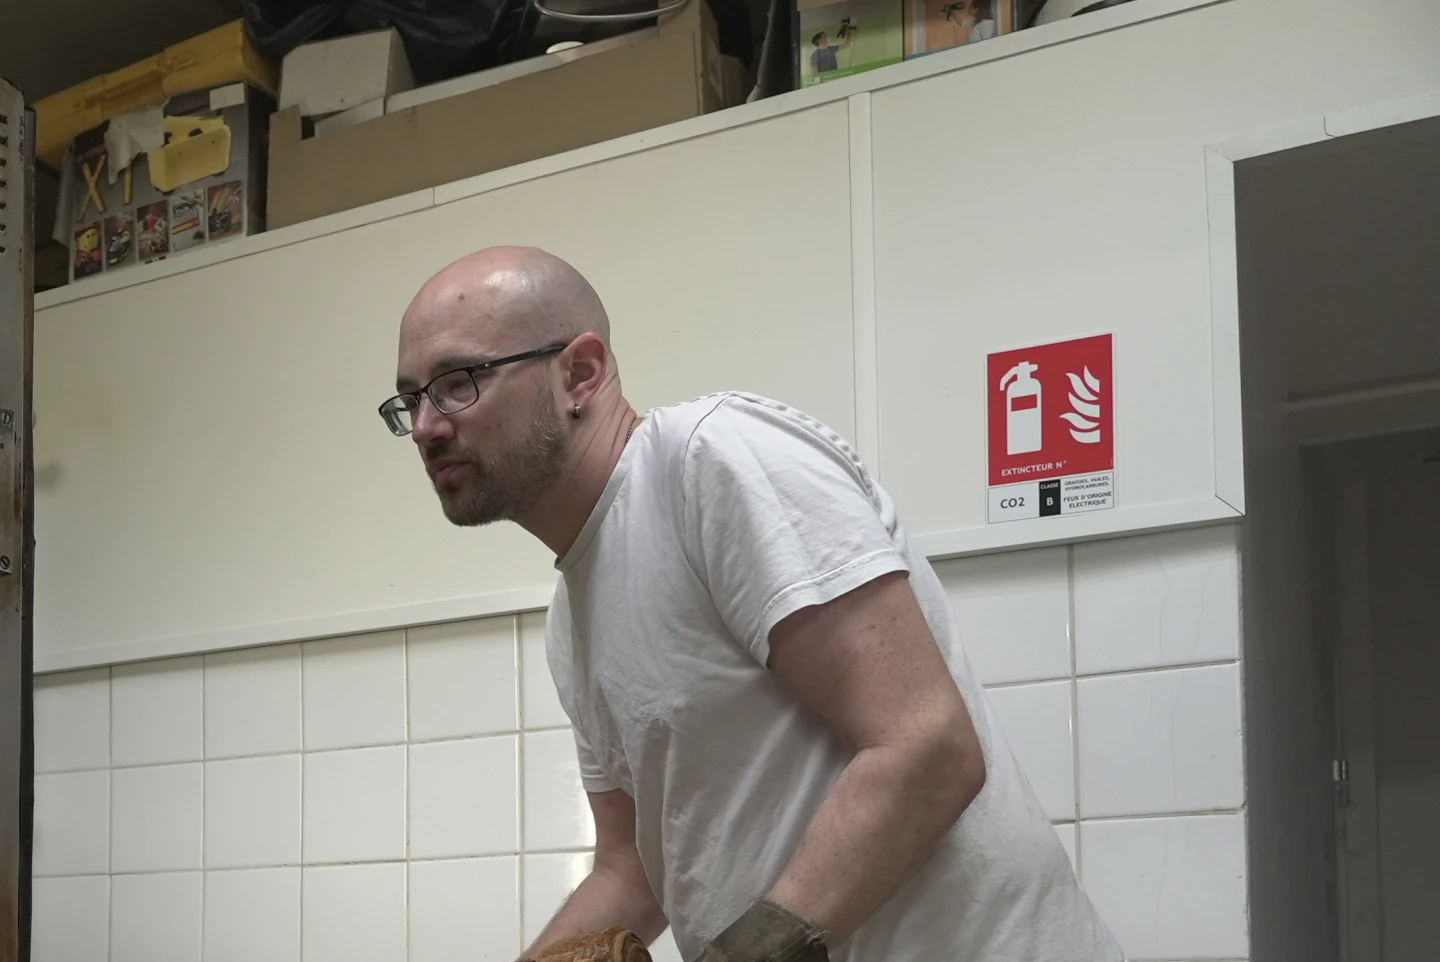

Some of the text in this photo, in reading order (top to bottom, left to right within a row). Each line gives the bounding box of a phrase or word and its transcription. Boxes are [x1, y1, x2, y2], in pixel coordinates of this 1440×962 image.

[1001, 460, 1067, 477] EXTINCTEUR N°
[1040, 482, 1059, 490] CLASSE
[1000, 497, 1025, 509] CO2
[1046, 497, 1054, 506] B
[1069, 499, 1106, 509] ELECTRIQUE
